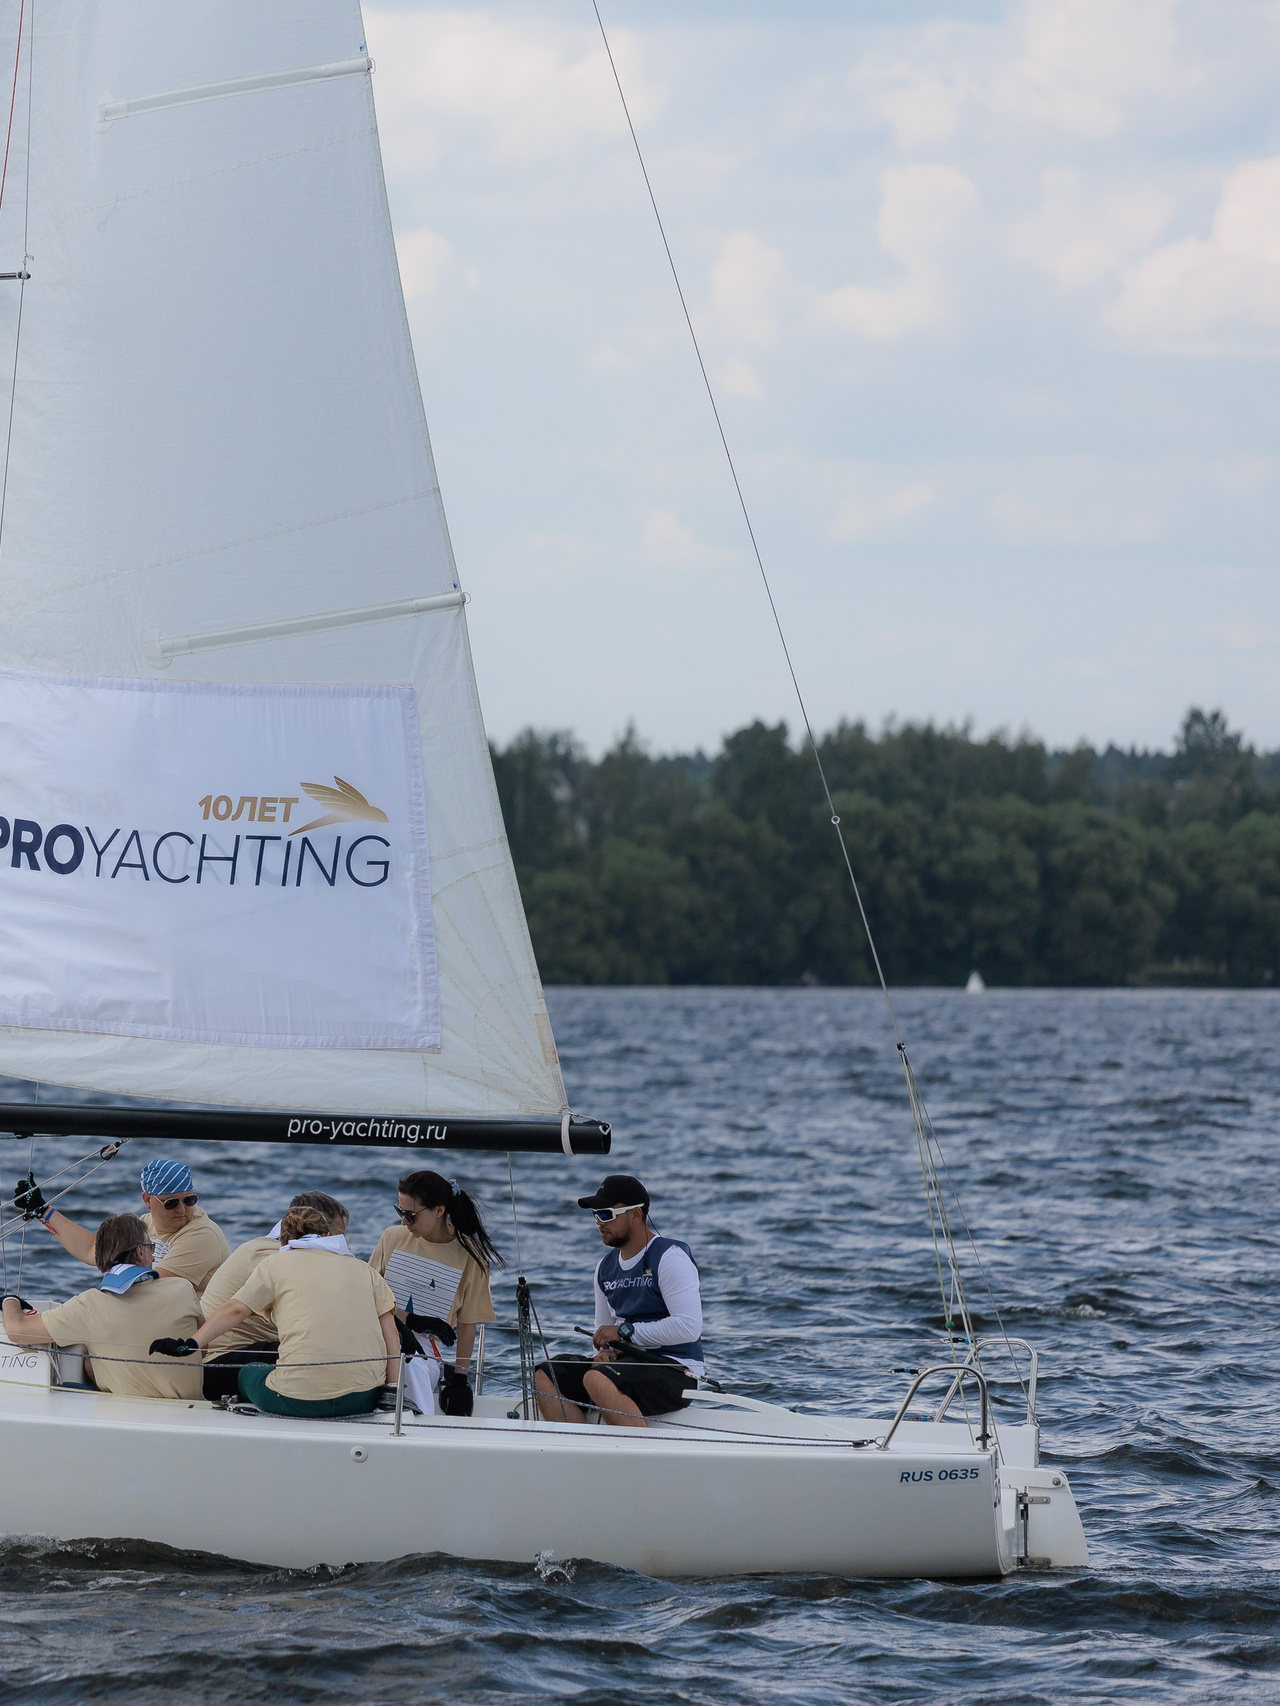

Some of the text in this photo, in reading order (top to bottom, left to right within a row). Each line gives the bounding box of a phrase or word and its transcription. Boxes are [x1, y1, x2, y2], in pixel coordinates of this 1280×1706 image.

[287, 1118, 448, 1144] pro-yachting.ru
[900, 1467, 980, 1483] RUS 0635
